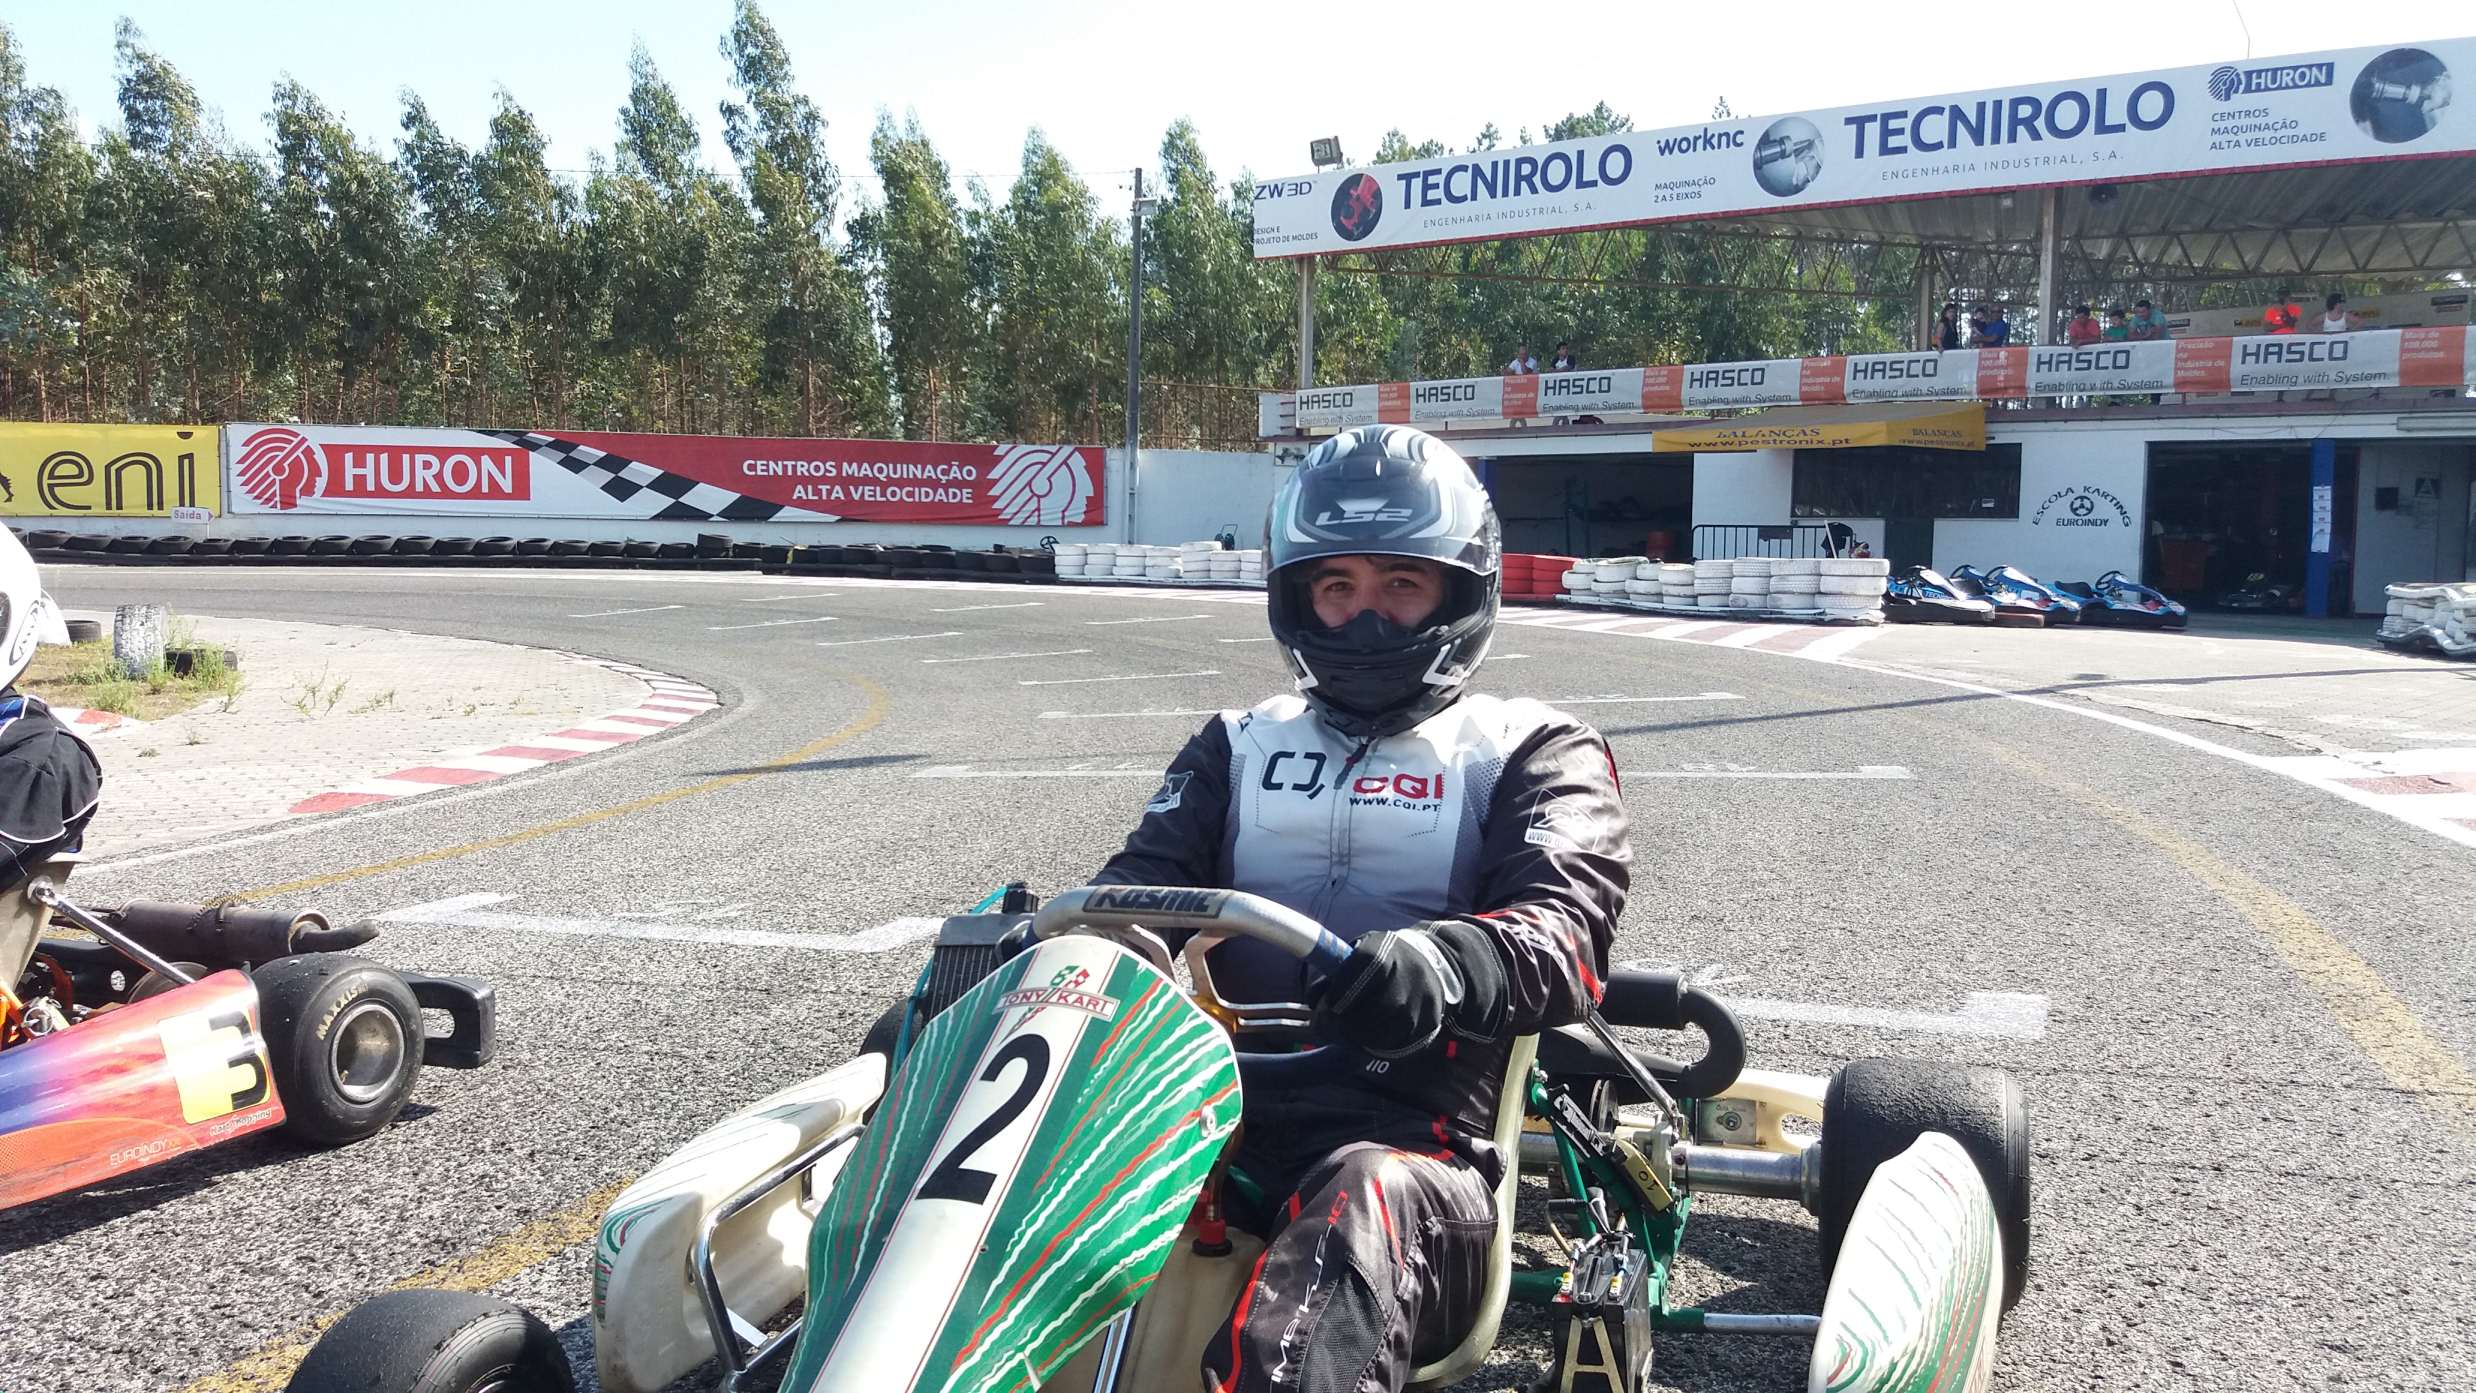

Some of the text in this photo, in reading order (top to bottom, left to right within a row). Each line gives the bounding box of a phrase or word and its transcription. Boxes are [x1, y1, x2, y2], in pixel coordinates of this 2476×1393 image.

[2250, 65, 2326, 91] HURON
[1844, 80, 2175, 160] TECNIROLO
[2211, 107, 2270, 122] CENTROS
[2210, 119, 2298, 137] MAQUINAÇÃO
[1656, 127, 1745, 157] worknc
[2209, 131, 2327, 151] ALTA VELOCIDADE
[1397, 143, 1633, 210] TECNIROLO
[1881, 162, 1977, 181] ENGENHARIA
[1983, 153, 2084, 172] INDUSTRIAL,
[1254, 181, 1312, 200] ZW3D
[1654, 176, 1716, 191] MAQUINAÇÃO
[1654, 191, 1702, 203] 2 A 5 EIXOS
[1423, 213, 1492, 229] ENGENHARIA
[1496, 205, 1569, 221] INDUSTRIAL,
[1254, 233, 1319, 246] ROJETO DE MOLDES
[2036, 349, 2131, 373] HASCO
[2241, 340, 2349, 365] HASCO
[1689, 367, 1766, 389] HASCO
[1852, 358, 1938, 381] HASCO
[2240, 374, 2298, 387] Enabling
[2303, 371, 2329, 384] with
[1415, 384, 1475, 404] HASCO
[1544, 376, 1611, 397] HASCO
[1852, 389, 1898, 400] Enabling
[1901, 387, 1923, 397] with
[2035, 381, 2086, 393] Enabling
[2088, 380, 2113, 391] with
[1300, 392, 1353, 411] HASCO
[1543, 403, 1580, 413] Enabling
[1581, 401, 1599, 411] with
[1688, 396, 1729, 406] Enabling
[1731, 395, 1751, 403] with
[1688, 437, 1851, 448] www.pestronix.pt
[37, 431, 196, 511] eni
[344, 452, 514, 494] HURON
[742, 459, 977, 485] CENTROS MAQUINAÇÃO
[792, 484, 974, 505] ALTA VELOCIDADE
[1315, 508, 1413, 526] LS2
[2032, 485, 2132, 528] ESCOLA KARTING
[2056, 518, 2110, 527] EUROINDY
[1094, 887, 1221, 913] KOSMIC
[1057, 991, 1115, 1014] KART
[315, 986, 358, 1041] MAXXIS
[209, 1010, 268, 1111] 3
[915, 1033, 1051, 1205] 2
